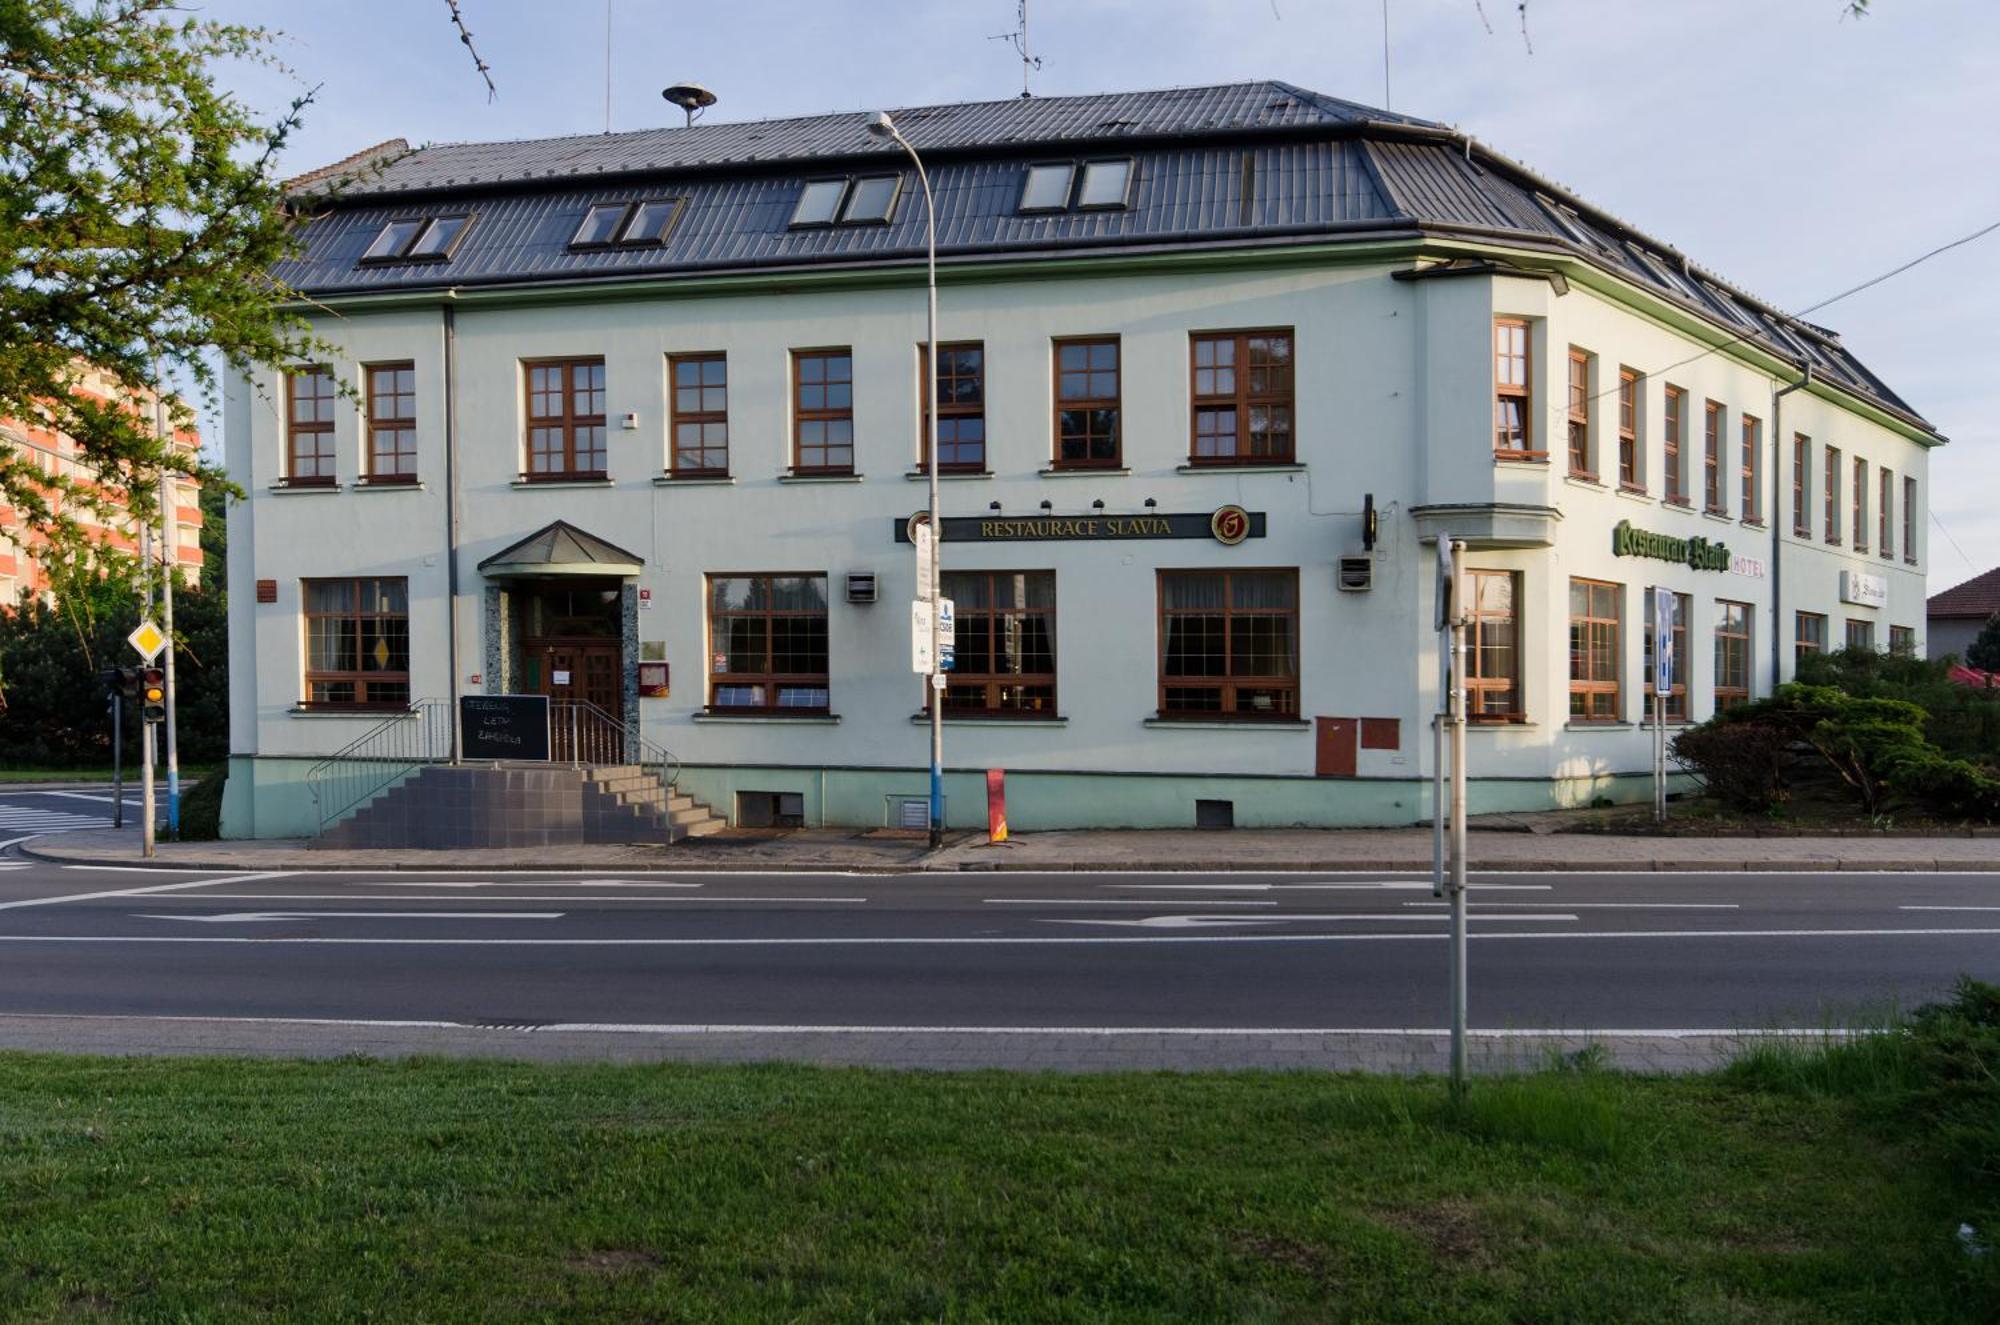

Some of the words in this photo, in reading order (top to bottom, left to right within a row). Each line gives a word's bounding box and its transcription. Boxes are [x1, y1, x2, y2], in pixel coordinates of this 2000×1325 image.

[981, 520, 1097, 537] RESTAURACE
[1107, 518, 1171, 534] SLAVIA
[1733, 557, 1764, 577] HOTEL
